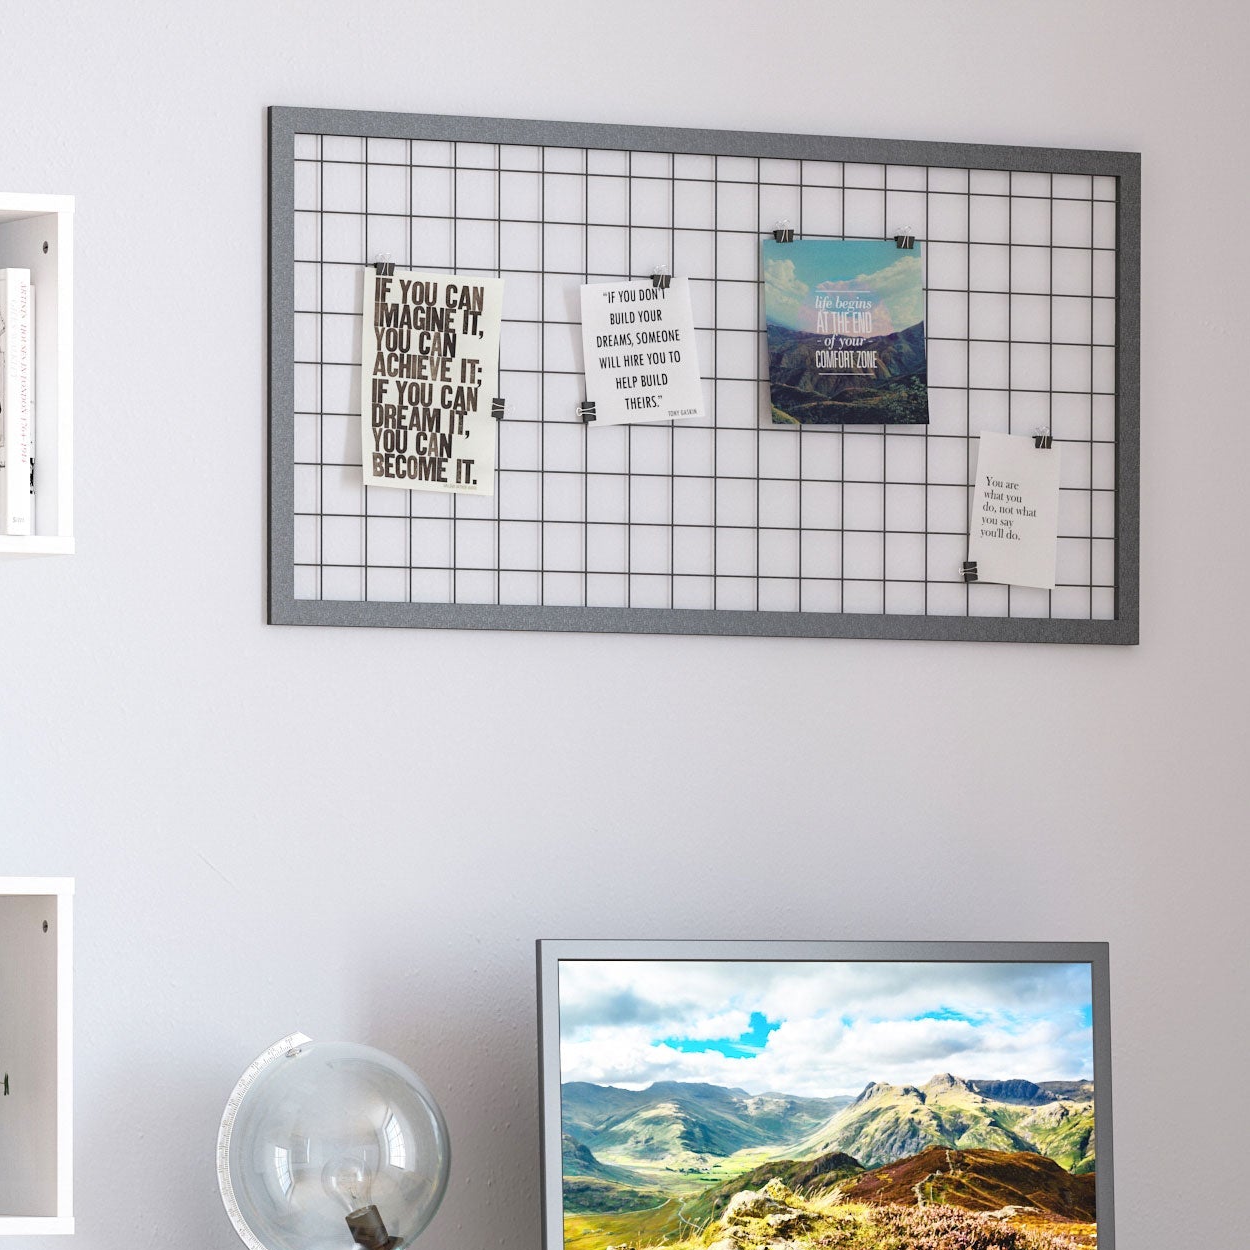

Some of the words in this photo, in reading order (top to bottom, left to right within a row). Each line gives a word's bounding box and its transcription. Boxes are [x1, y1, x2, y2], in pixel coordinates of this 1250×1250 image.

[375, 278, 391, 303] IF
[399, 279, 437, 305] YOU
[445, 284, 484, 311] CAN
[618, 290, 636, 302] YOU
[815, 296, 832, 309] life
[836, 296, 871, 311] begins
[374, 303, 456, 333] IMAGINE
[463, 310, 484, 339] IT,
[610, 311, 635, 325] BUILD
[638, 310, 662, 322] YOUR
[817, 312, 828, 333] AT
[832, 312, 850, 333] THE
[853, 312, 872, 333] END
[374, 328, 410, 353] YOU
[419, 331, 456, 358] CAN
[597, 333, 634, 347] DREAMS,
[636, 329, 680, 345] SOMEONE
[824, 335, 835, 350] of
[840, 337, 865, 350] your
[599, 354, 620, 369] WILL
[624, 354, 644, 367] HIRE
[647, 352, 665, 365] YOU
[669, 351, 681, 362] TO
[816, 351, 854, 368] COMFORT
[857, 351, 877, 368] ZONE
[373, 352, 452, 382] ACHIEVE
[461, 359, 482, 387] IT;
[616, 376, 638, 389] HELP
[641, 374, 668, 387] BUILD
[372, 378, 389, 403] IF
[396, 380, 433, 407] YOU
[441, 386, 478, 412] CAN
[372, 403, 441, 433] DREAM
[450, 409, 469, 439] IT,
[373, 428, 407, 453] YOU
[416, 432, 452, 458] CAN
[372, 452, 447, 483] BECOME
[456, 459, 477, 485] IT.
[986, 477, 1003, 488] You
[1006, 482, 1019, 490] are
[984, 491, 1003, 500] what
[1006, 495, 1022, 503] you
[983, 503, 996, 513] do,
[1000, 504, 1013, 515] not
[1016, 507, 1036, 517] what
[982, 516, 997, 525] you
[1000, 518, 1014, 527] say
[980, 528, 1003, 538] you'll
[1006, 530, 1020, 541] do.
